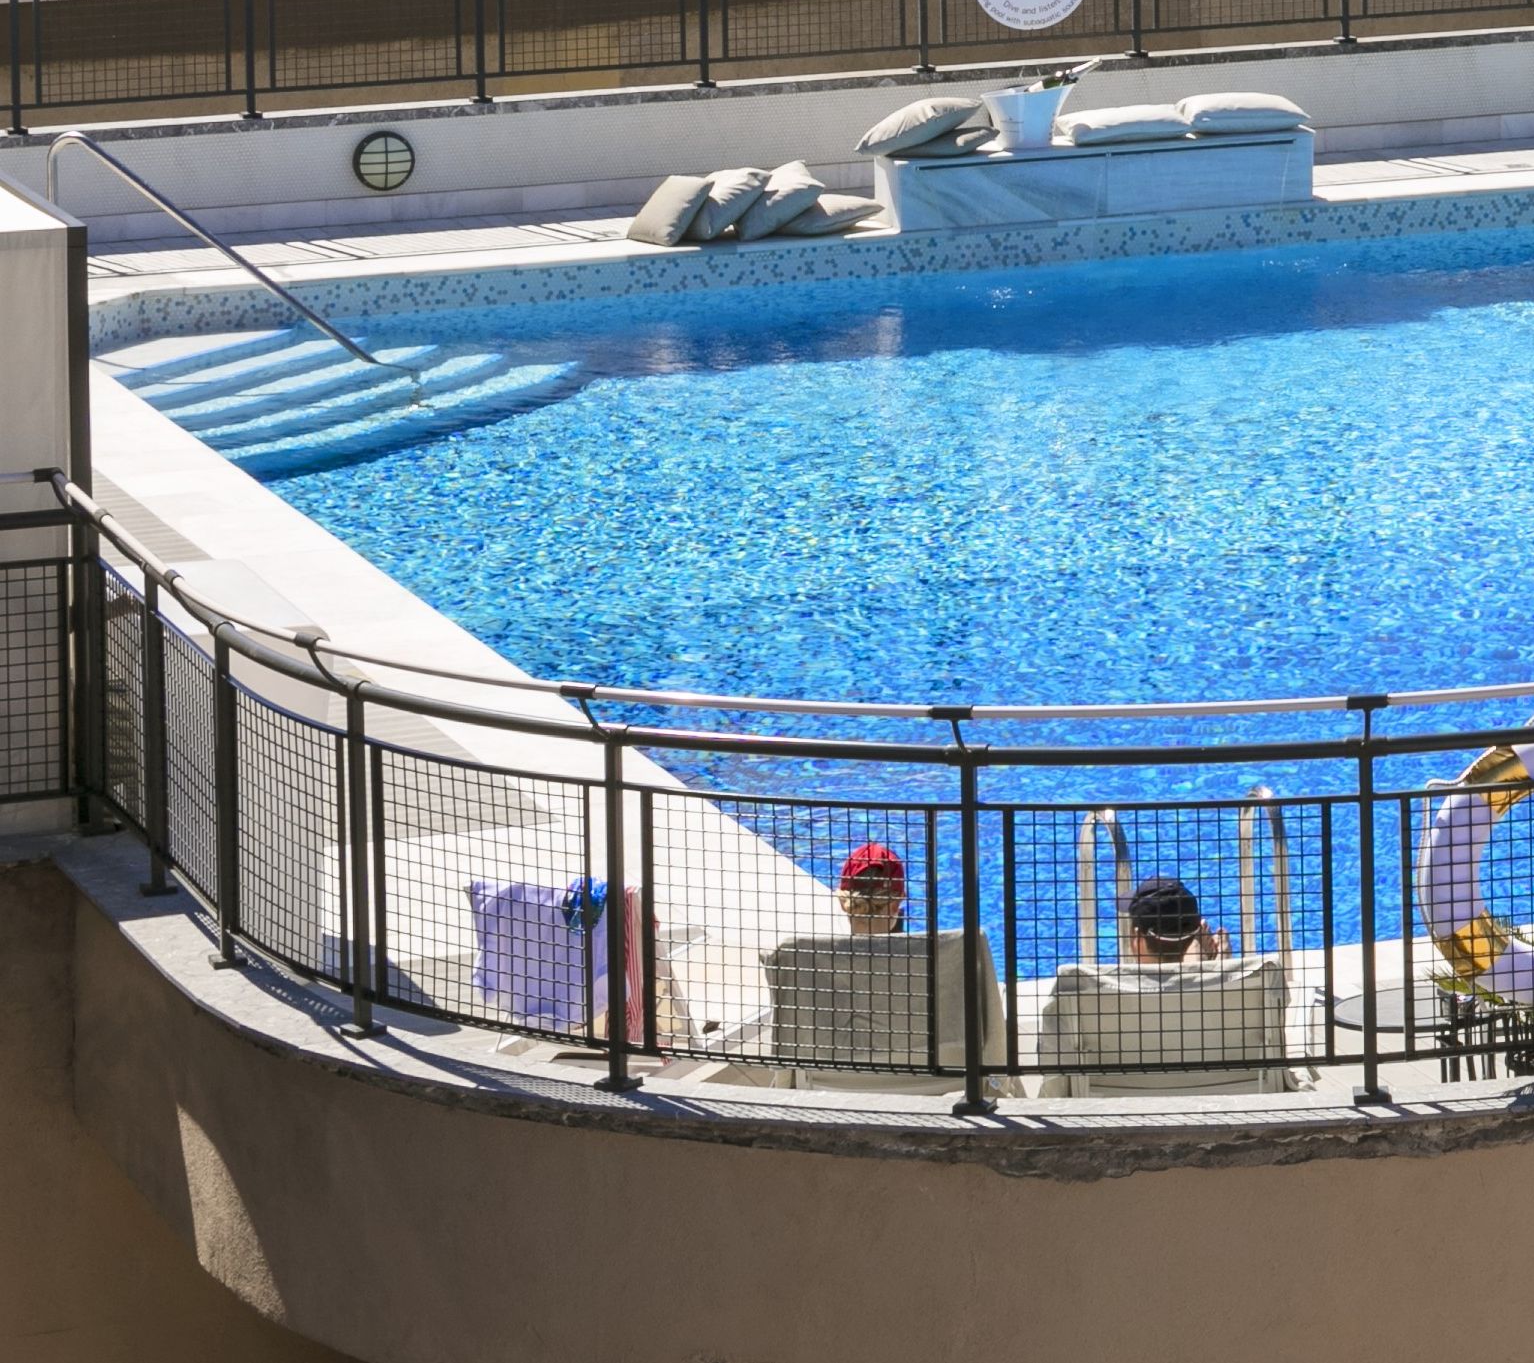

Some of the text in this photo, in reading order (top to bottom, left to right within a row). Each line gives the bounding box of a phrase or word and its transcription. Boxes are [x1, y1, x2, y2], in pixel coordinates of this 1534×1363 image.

[990, 6, 1006, 19] pool
[1006, 16, 1021, 25] with
[1023, 11, 1062, 26] subaquatic
[1002, 0, 1020, 13] Dive
[1021, 6, 1036, 15] and
